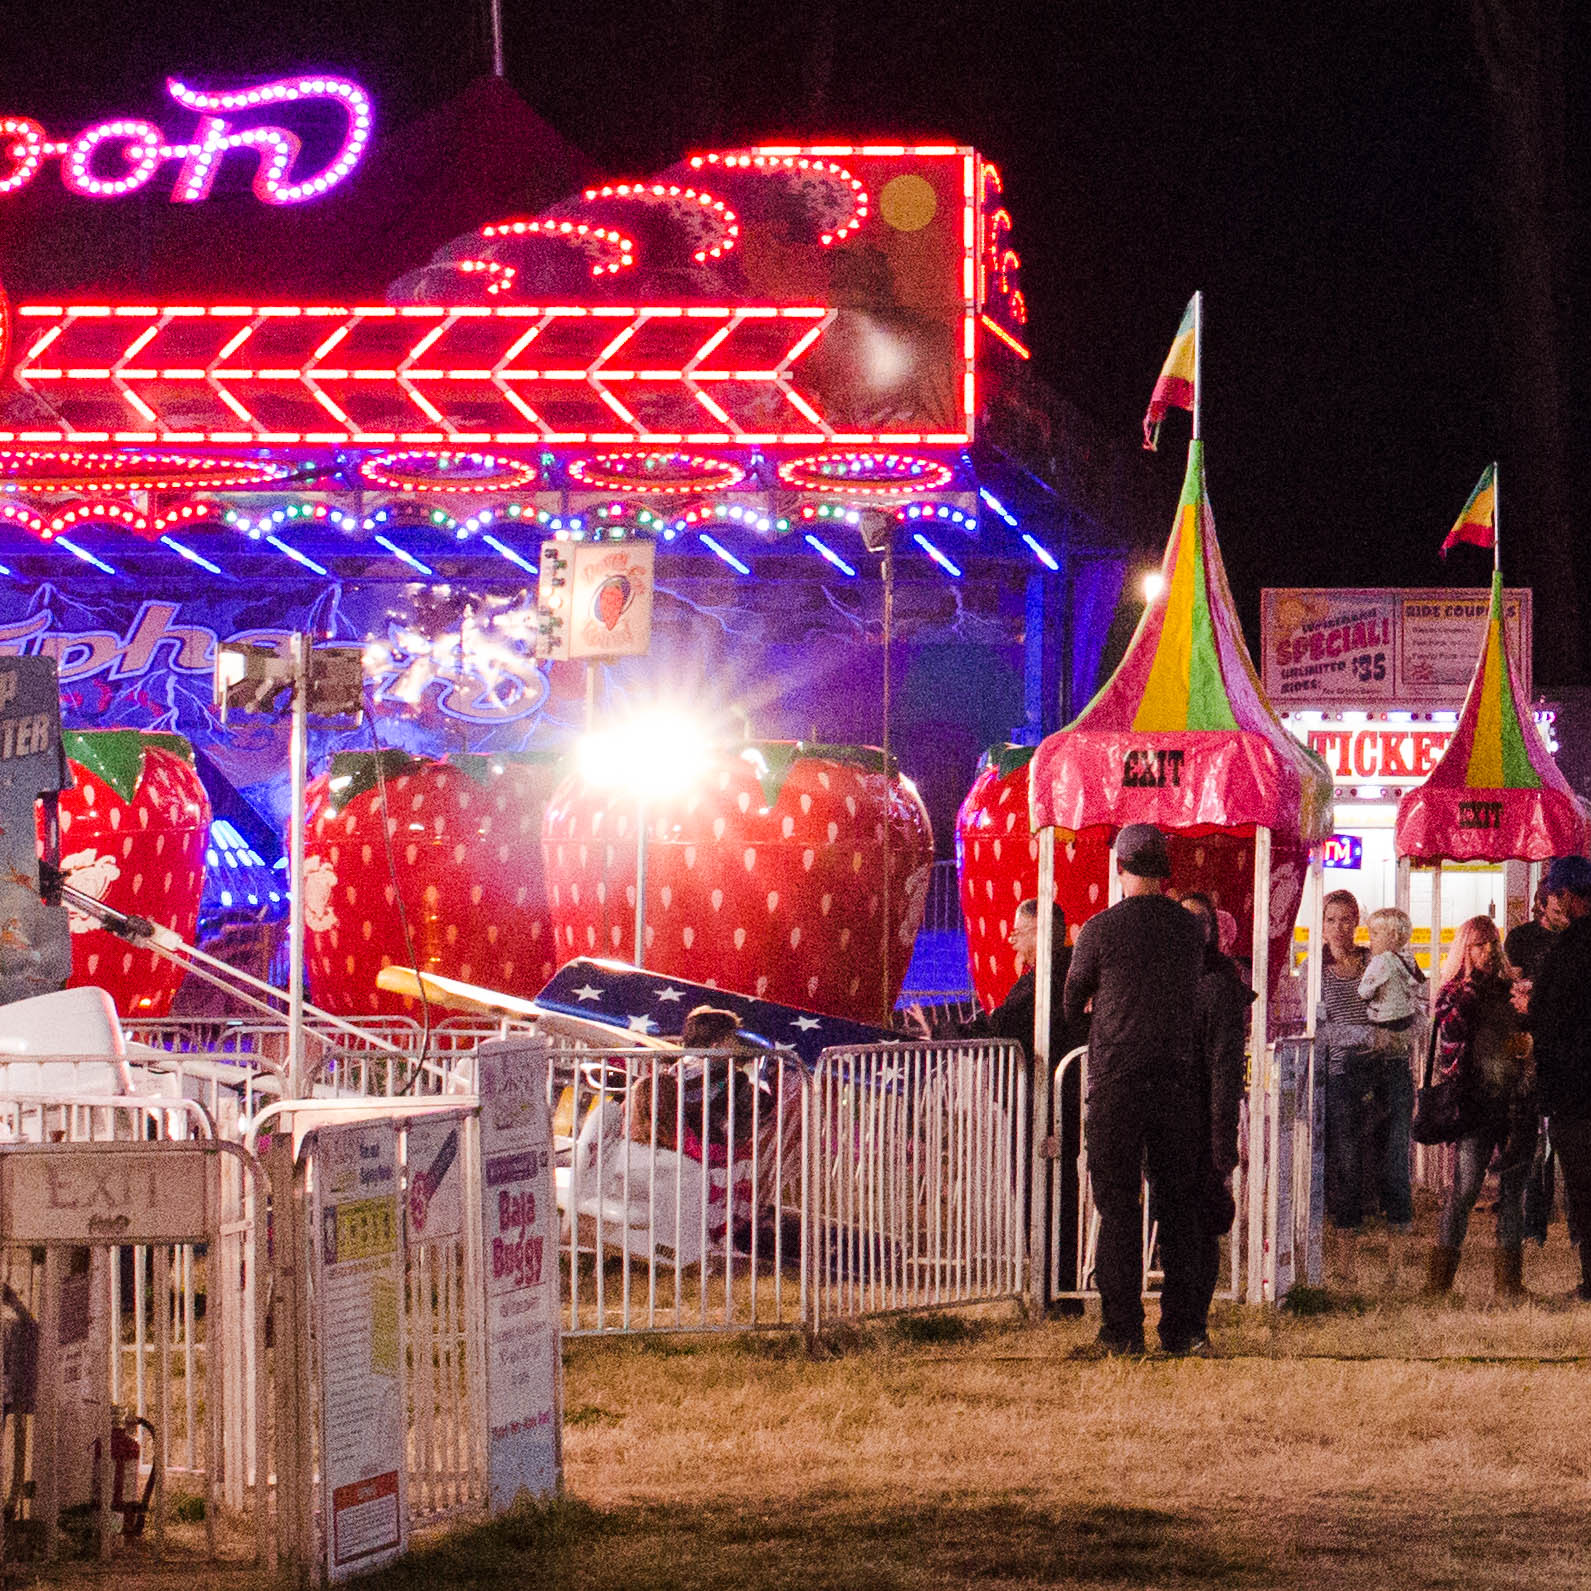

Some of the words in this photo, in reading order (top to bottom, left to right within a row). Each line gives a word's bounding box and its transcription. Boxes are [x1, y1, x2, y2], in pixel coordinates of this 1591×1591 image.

[1405, 605, 1441, 618] RIDE
[1275, 618, 1390, 667] SPECIAL!
[1351, 652, 1387, 683] $35
[1121, 749, 1185, 788] EXIT
[1308, 730, 1455, 777] TICKE
[1458, 800, 1504, 829] EXIT
[45, 1160, 163, 1211] EXIT
[498, 1189, 537, 1240] Baja
[491, 1235, 544, 1286] Buggy
